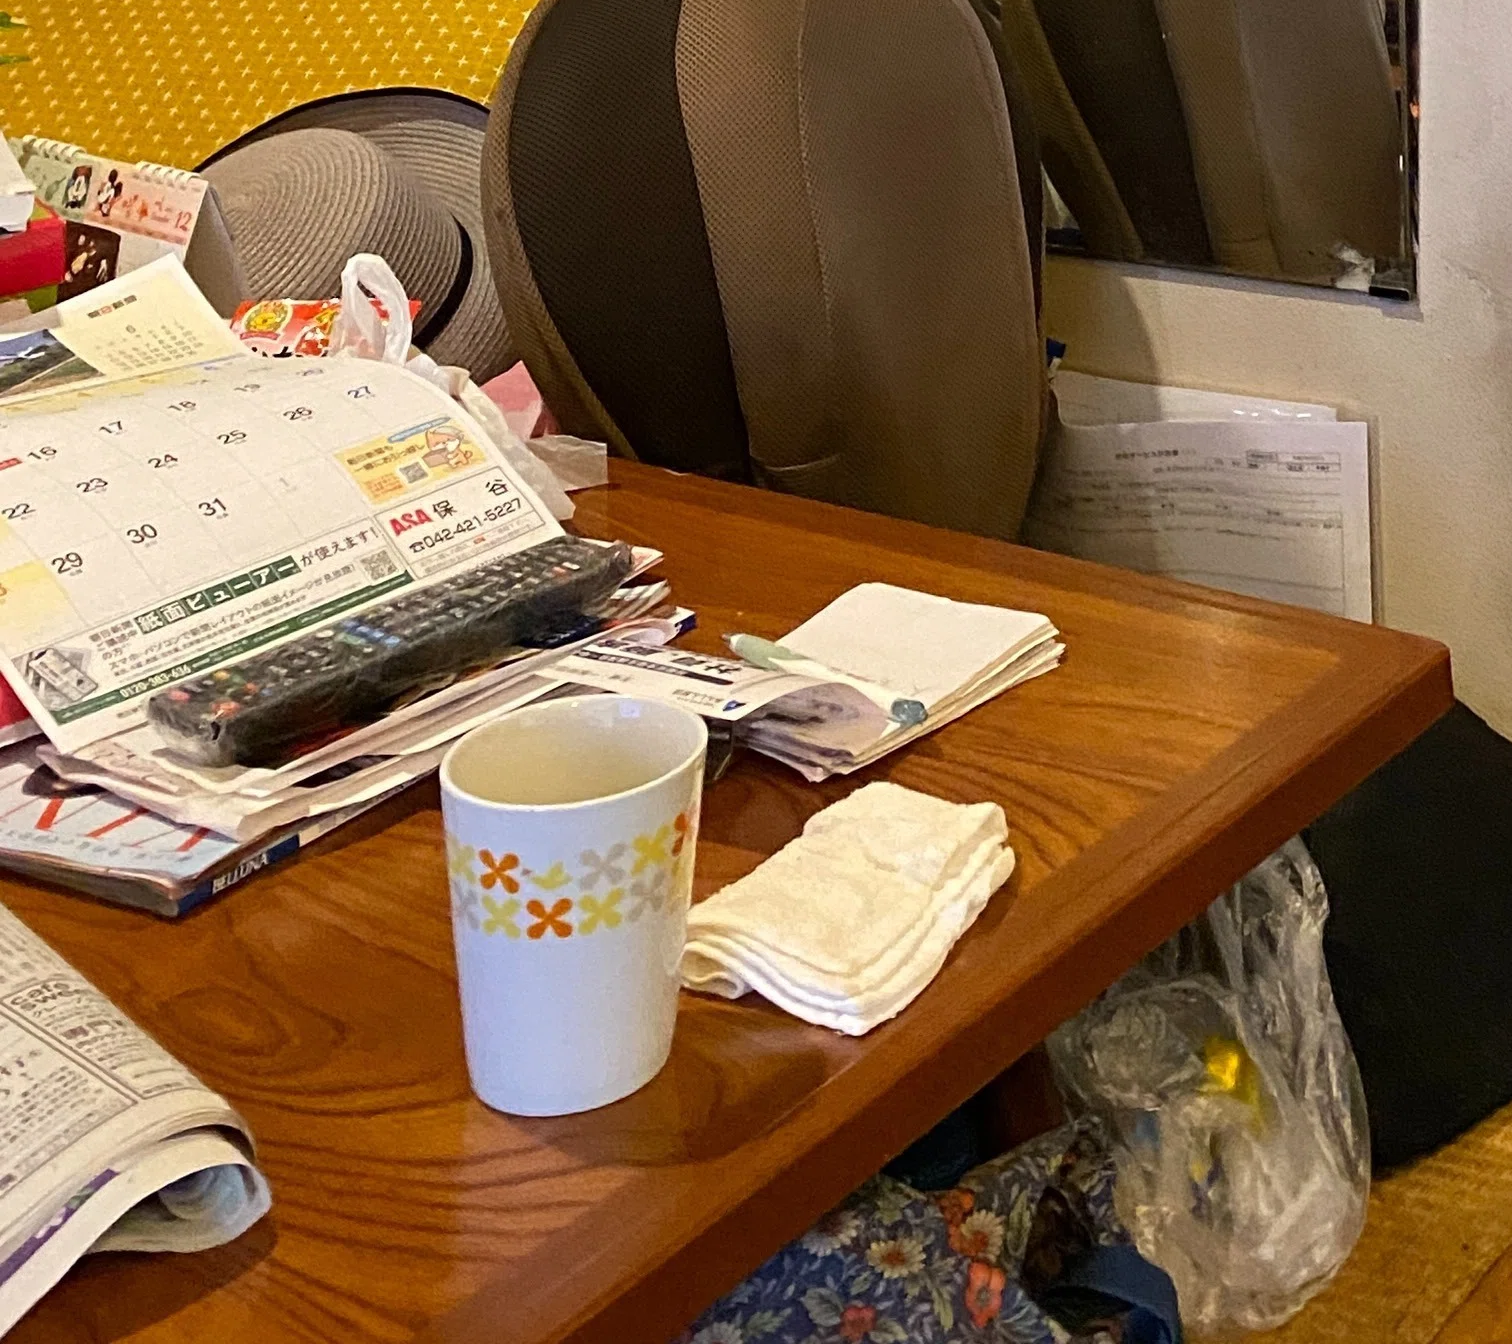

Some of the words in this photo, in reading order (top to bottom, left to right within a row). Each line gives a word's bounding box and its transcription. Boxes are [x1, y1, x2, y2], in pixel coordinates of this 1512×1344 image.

[347, 385, 371, 399] 27
[99, 420, 124, 435] 17
[216, 429, 247, 445] 25
[27, 446, 58, 461] 16
[148, 453, 179, 469] 24
[76, 477, 109, 493] 23
[2, 503, 36, 520] 22
[198, 497, 228, 517] 31
[389, 509, 434, 537] ASA
[423, 497, 523, 549] 042-421-5227
[126, 523, 158, 544] 30
[51, 551, 84, 575] 29
